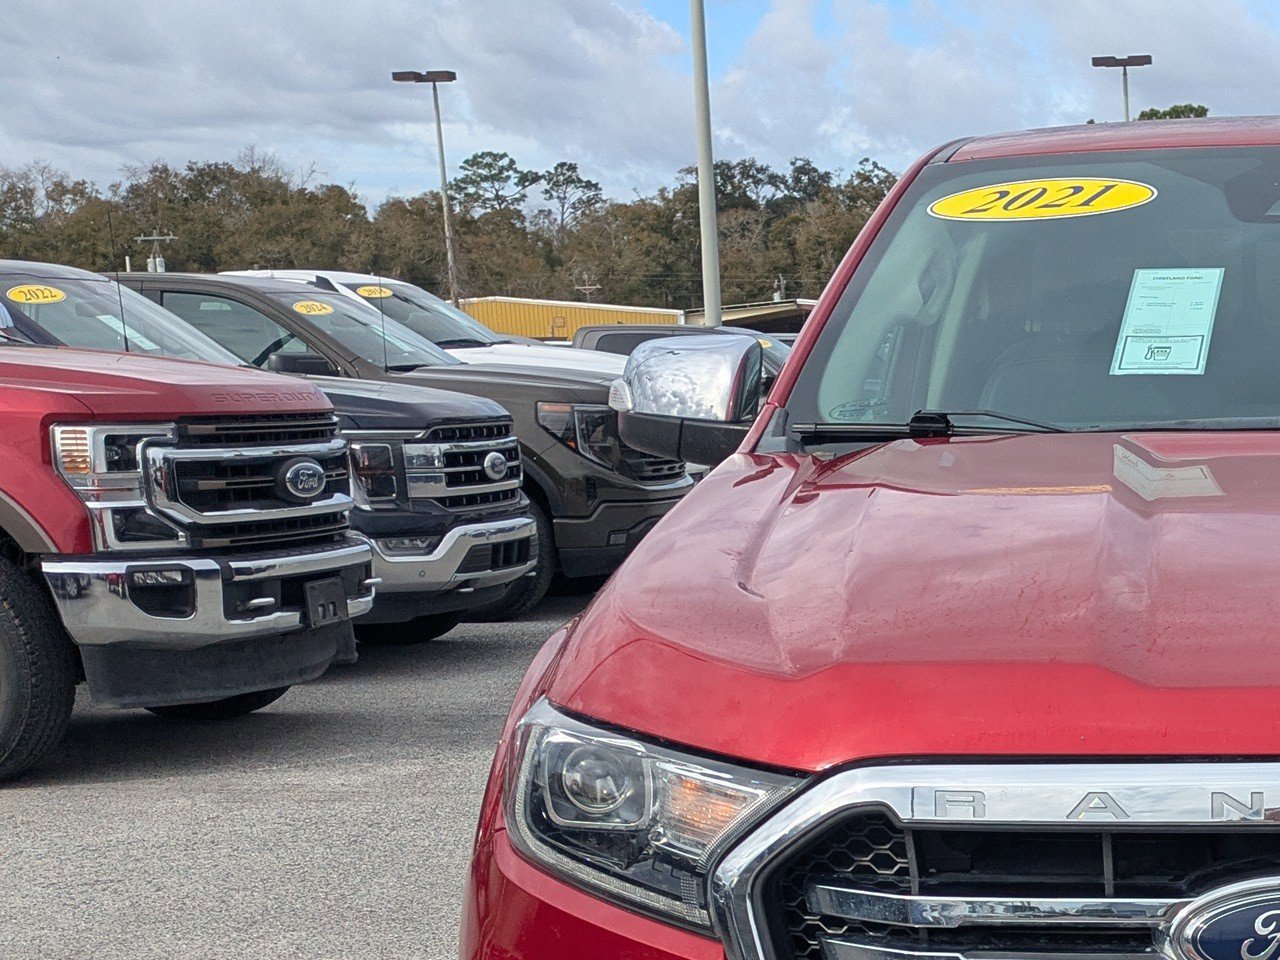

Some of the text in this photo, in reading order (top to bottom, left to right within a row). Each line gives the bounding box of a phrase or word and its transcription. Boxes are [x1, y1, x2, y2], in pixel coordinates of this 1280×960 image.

[960, 183, 1119, 215] 2021
[18, 287, 57, 302] 2022
[298, 470, 319, 490] Ford
